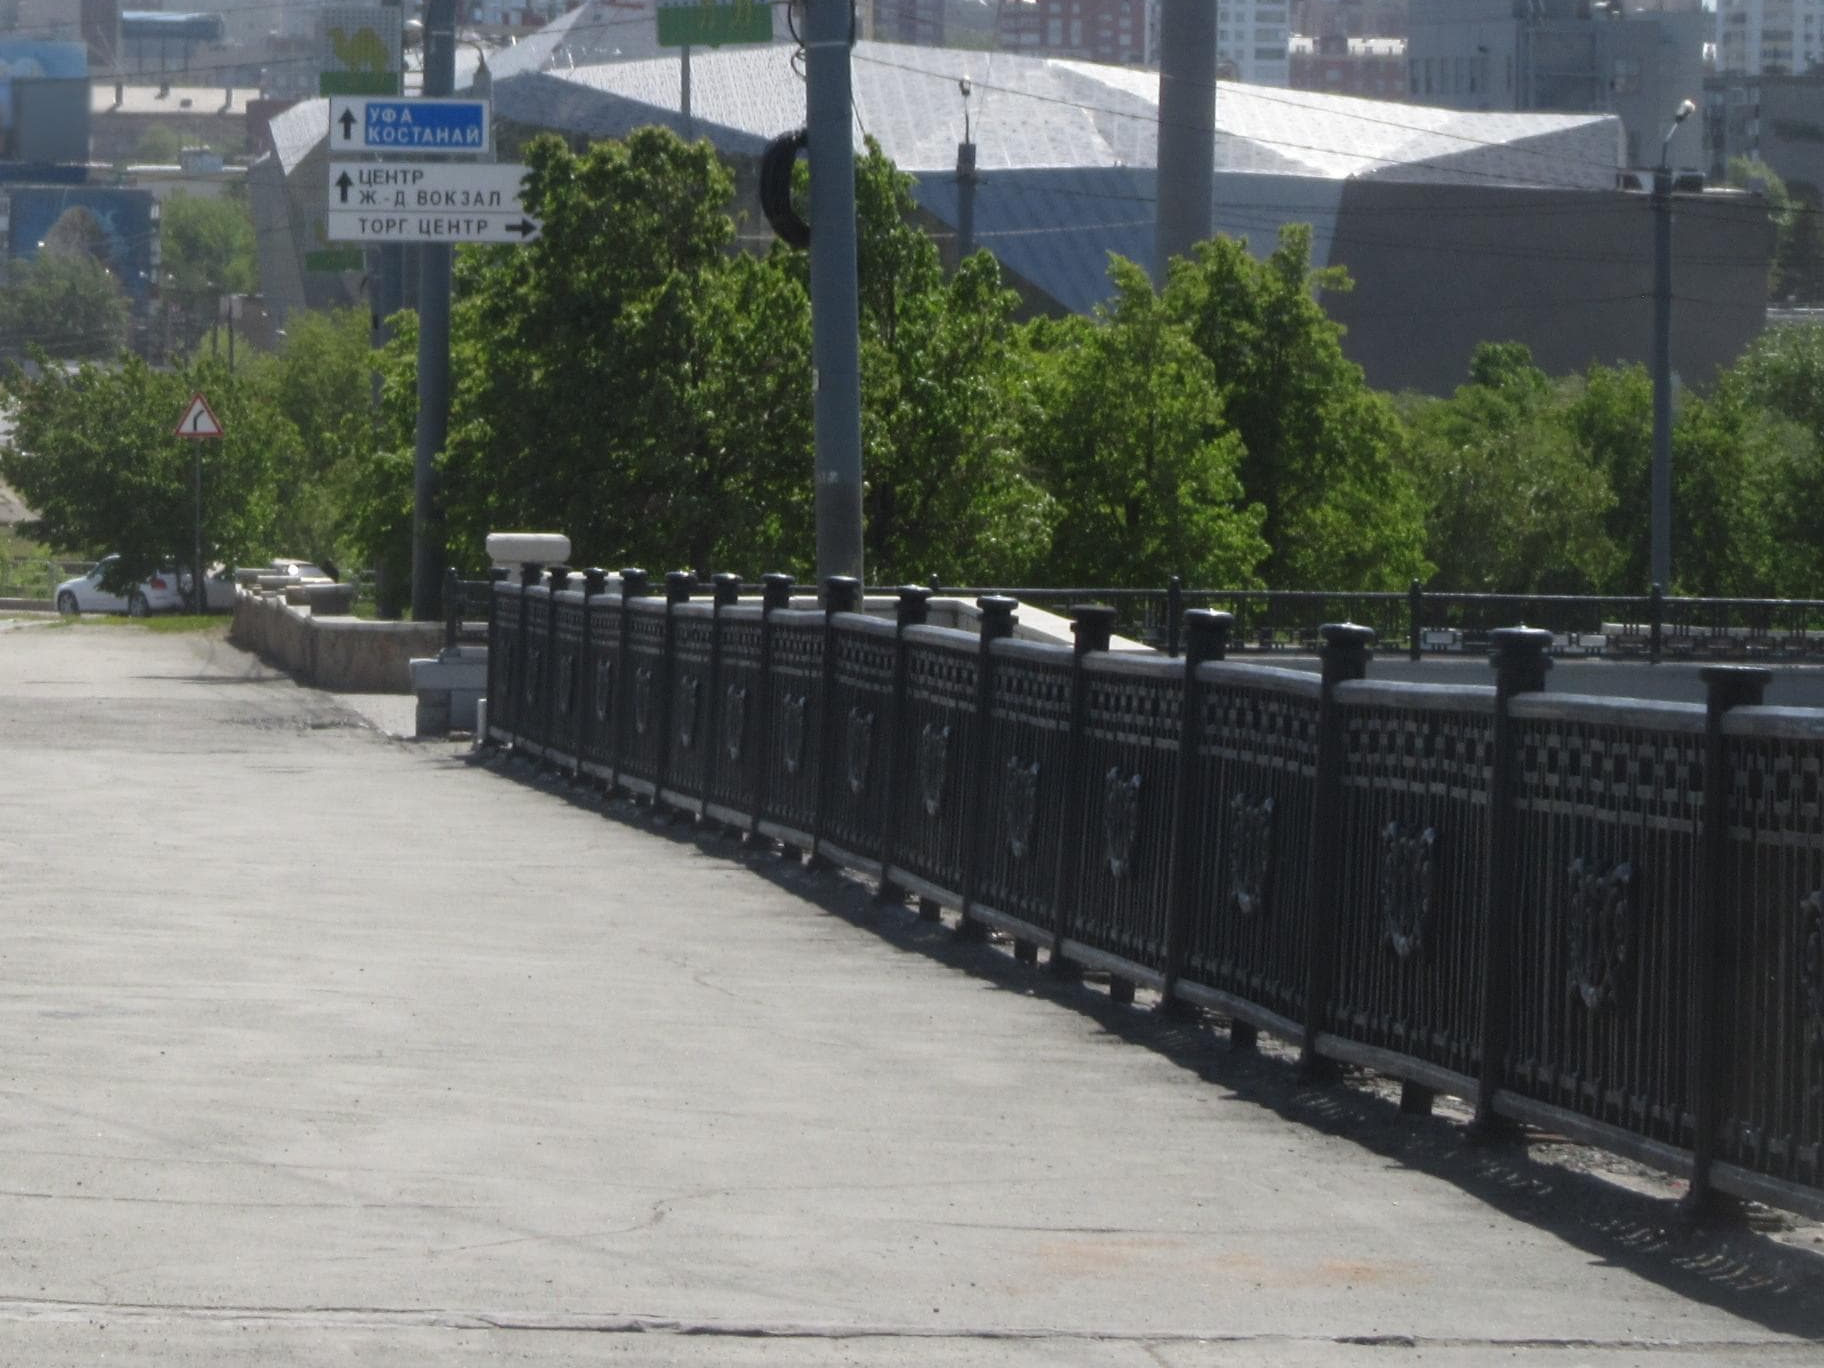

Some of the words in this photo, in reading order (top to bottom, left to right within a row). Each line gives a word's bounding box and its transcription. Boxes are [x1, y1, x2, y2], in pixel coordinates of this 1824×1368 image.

[368, 107, 413, 123] УФА
[368, 124, 480, 144] КОСТАНАЙ
[359, 168, 424, 187] ЦЕНТР
[417, 190, 501, 207] ВОКЗАЛ
[419, 219, 489, 236] ЦЕНТР
